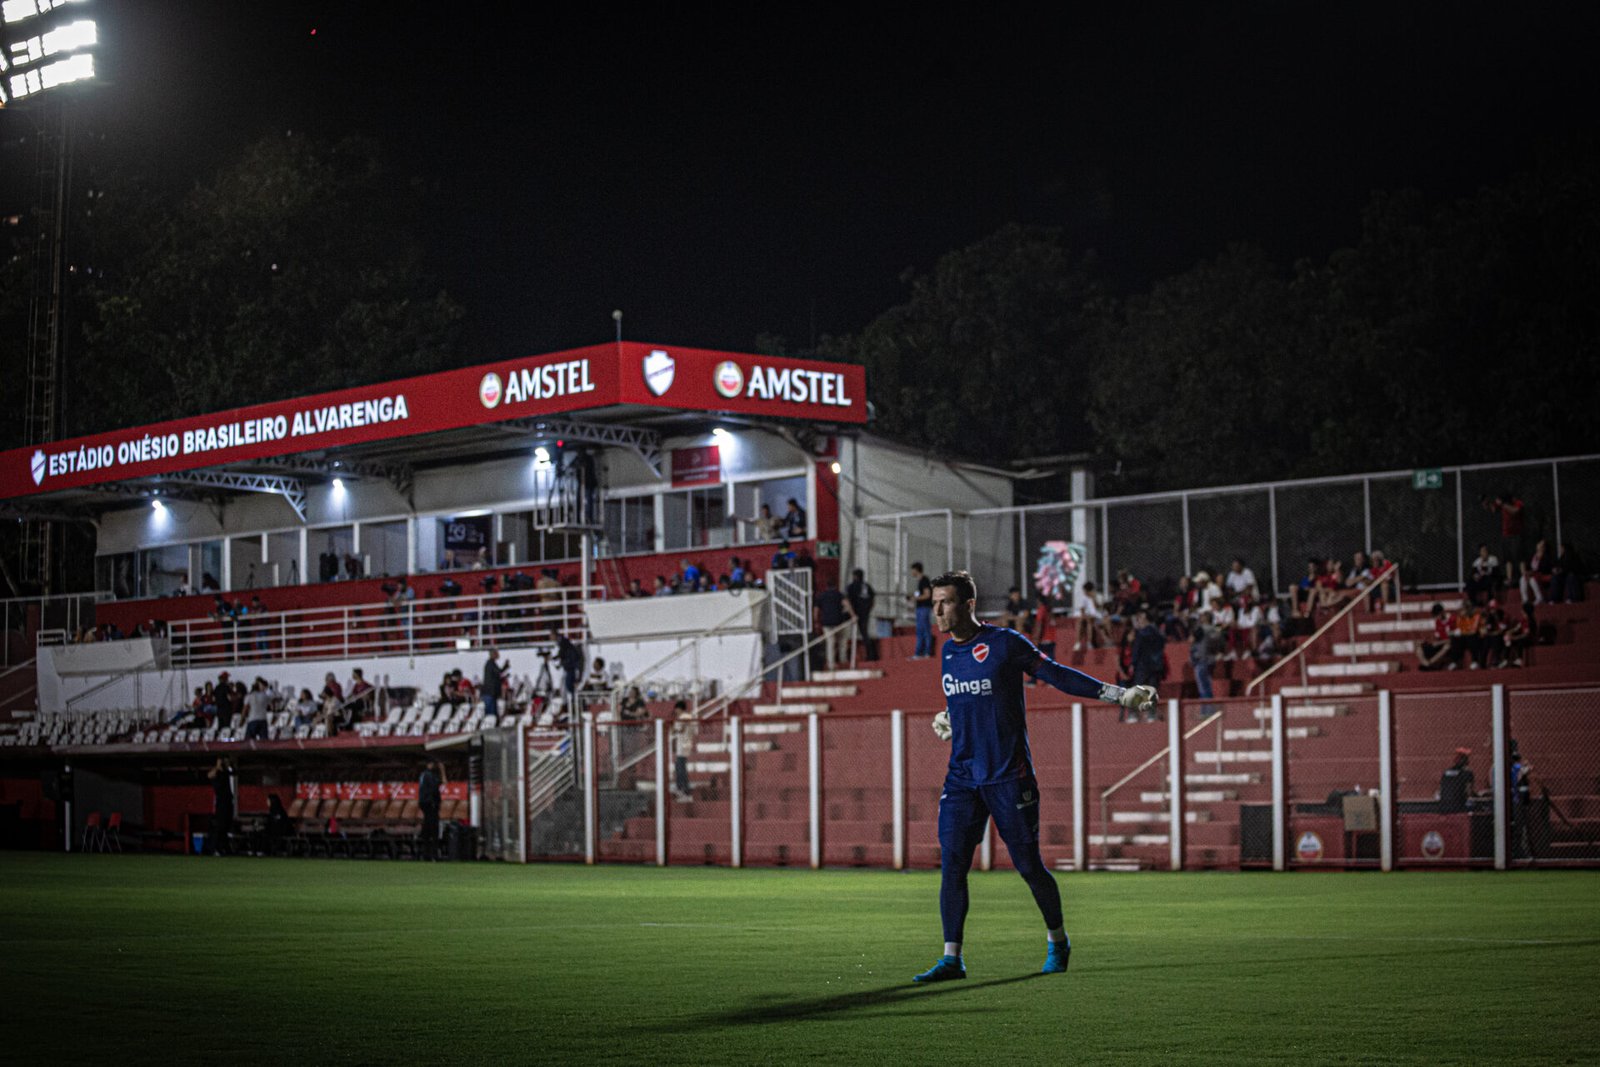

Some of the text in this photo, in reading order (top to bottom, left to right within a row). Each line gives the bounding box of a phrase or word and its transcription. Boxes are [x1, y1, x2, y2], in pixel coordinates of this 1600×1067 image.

[504, 359, 595, 404] AMSTEL
[747, 366, 852, 406] AMSTEL
[49, 394, 408, 476] ESTÁDIO ONÉSIO BRASILEIRO ALVARENGA
[942, 673, 992, 697] Ginga
